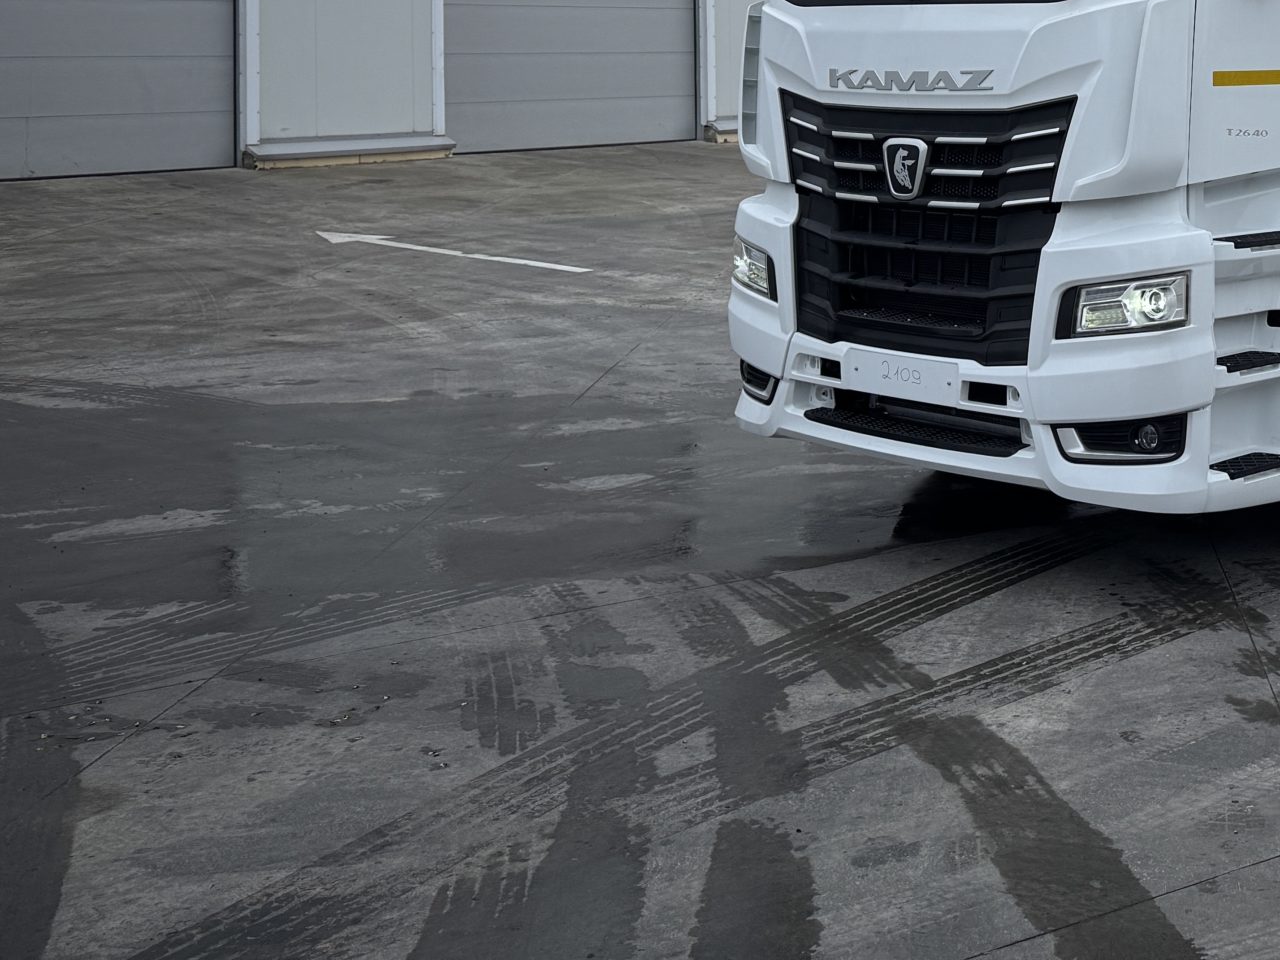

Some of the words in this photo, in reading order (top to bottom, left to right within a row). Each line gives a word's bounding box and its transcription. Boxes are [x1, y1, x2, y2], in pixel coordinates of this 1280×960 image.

[829, 68, 994, 91] KAMAZ
[1226, 128, 1269, 138] T2640
[881, 360, 921, 385] 2109
